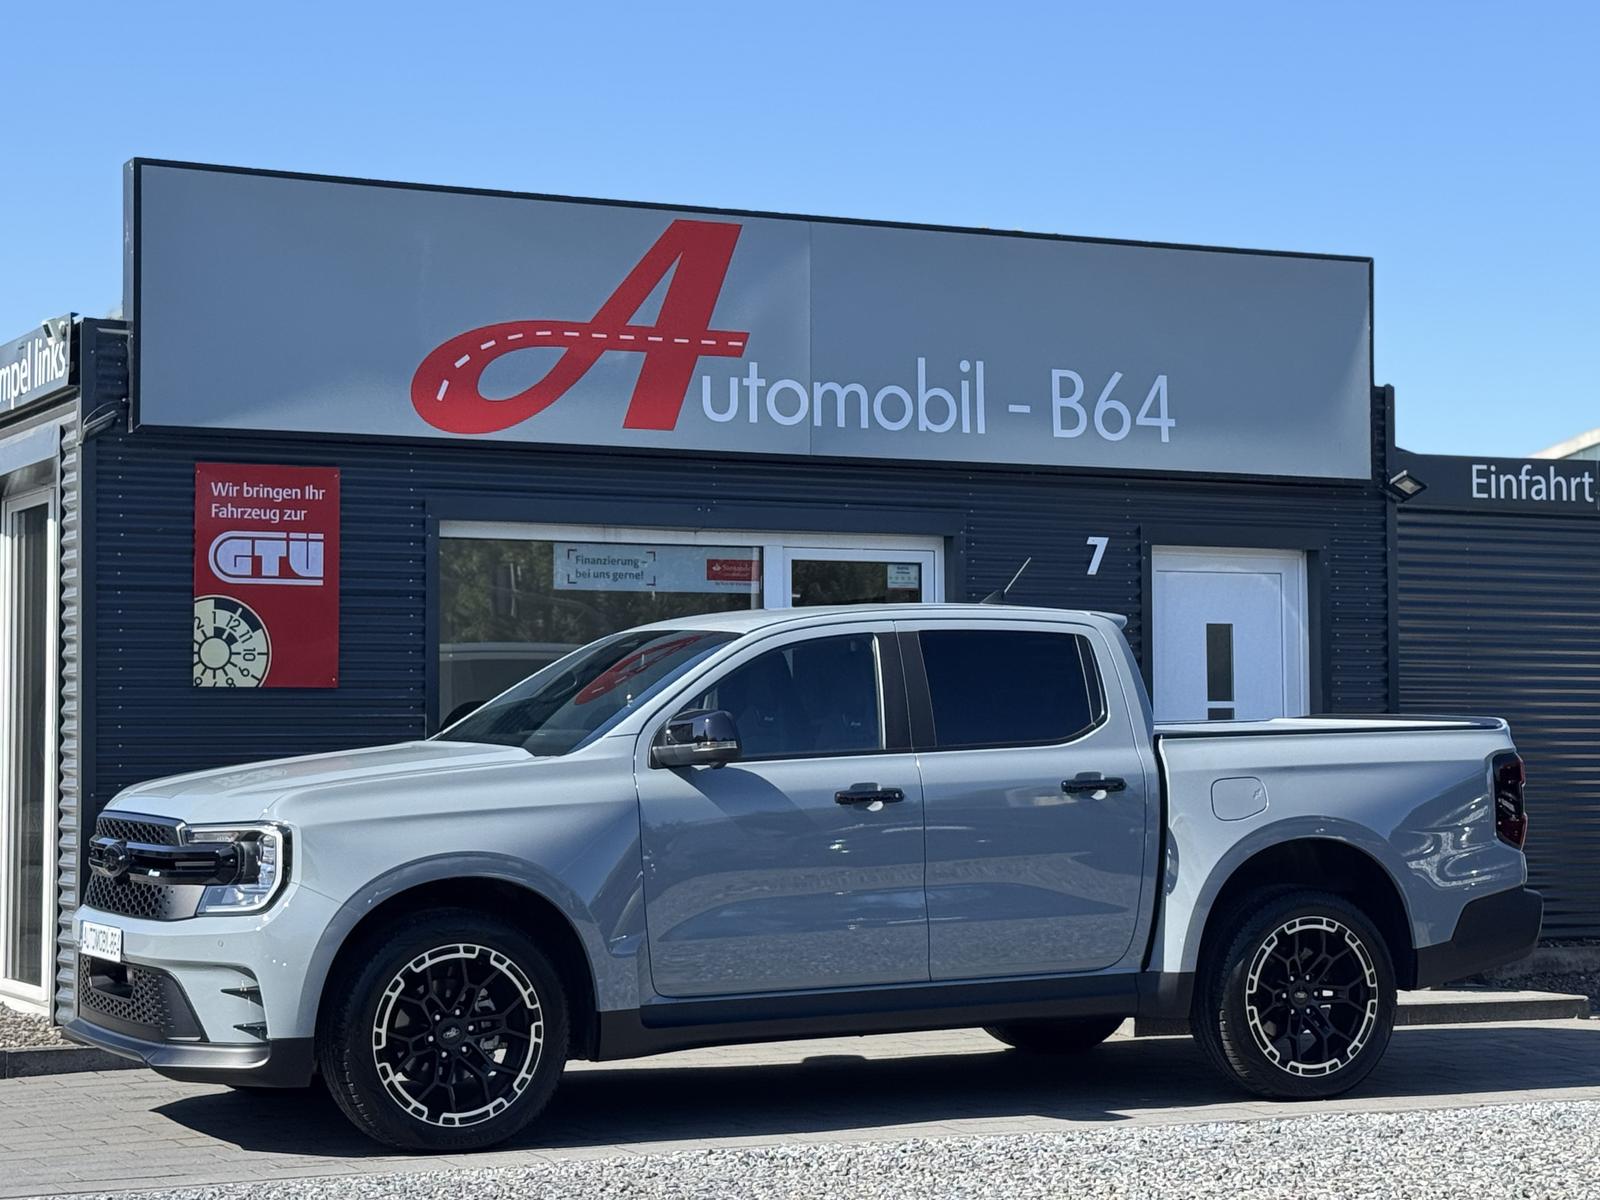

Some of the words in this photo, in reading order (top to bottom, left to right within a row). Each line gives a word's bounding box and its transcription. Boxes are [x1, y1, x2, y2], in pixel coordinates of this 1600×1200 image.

[34, 338, 66, 389] links
[1051, 368, 1176, 443] B64
[210, 481, 240, 498] Wir
[243, 482, 301, 502] bringen
[305, 484, 326, 500] Ihr
[1471, 464, 1594, 503] Einfahrt
[210, 503, 280, 523] Fahrzeug
[283, 509, 308, 521] zur
[208, 530, 325, 586] GTÜ
[575, 553, 640, 569] Finanzierung
[575, 569, 591, 579] bei
[593, 571, 610, 579] uns
[611, 570, 644, 582] gerne!
[1086, 536, 1110, 576] 7
